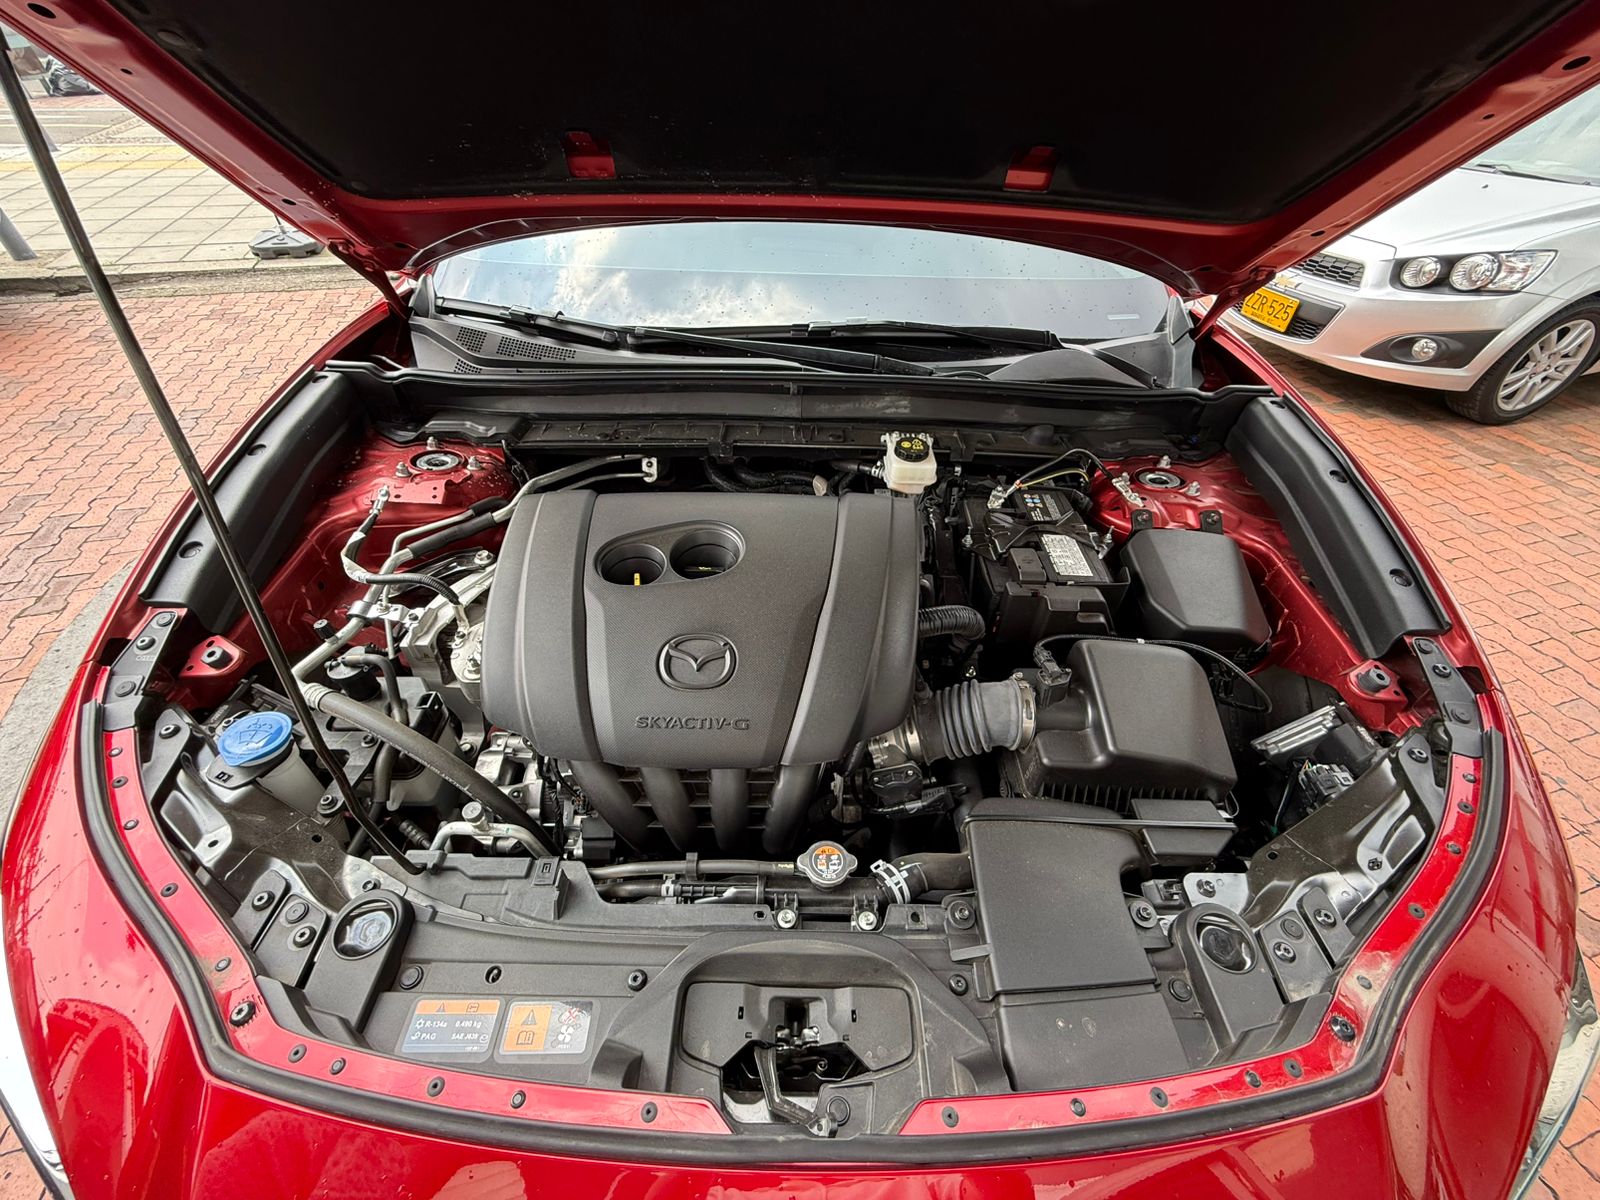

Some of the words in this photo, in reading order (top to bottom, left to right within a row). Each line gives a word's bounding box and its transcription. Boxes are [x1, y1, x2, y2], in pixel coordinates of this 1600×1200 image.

[1267, 299, 1294, 321] 525
[635, 715, 751, 730] SKYACTIV-G
[420, 1032, 437, 1040] PAG
